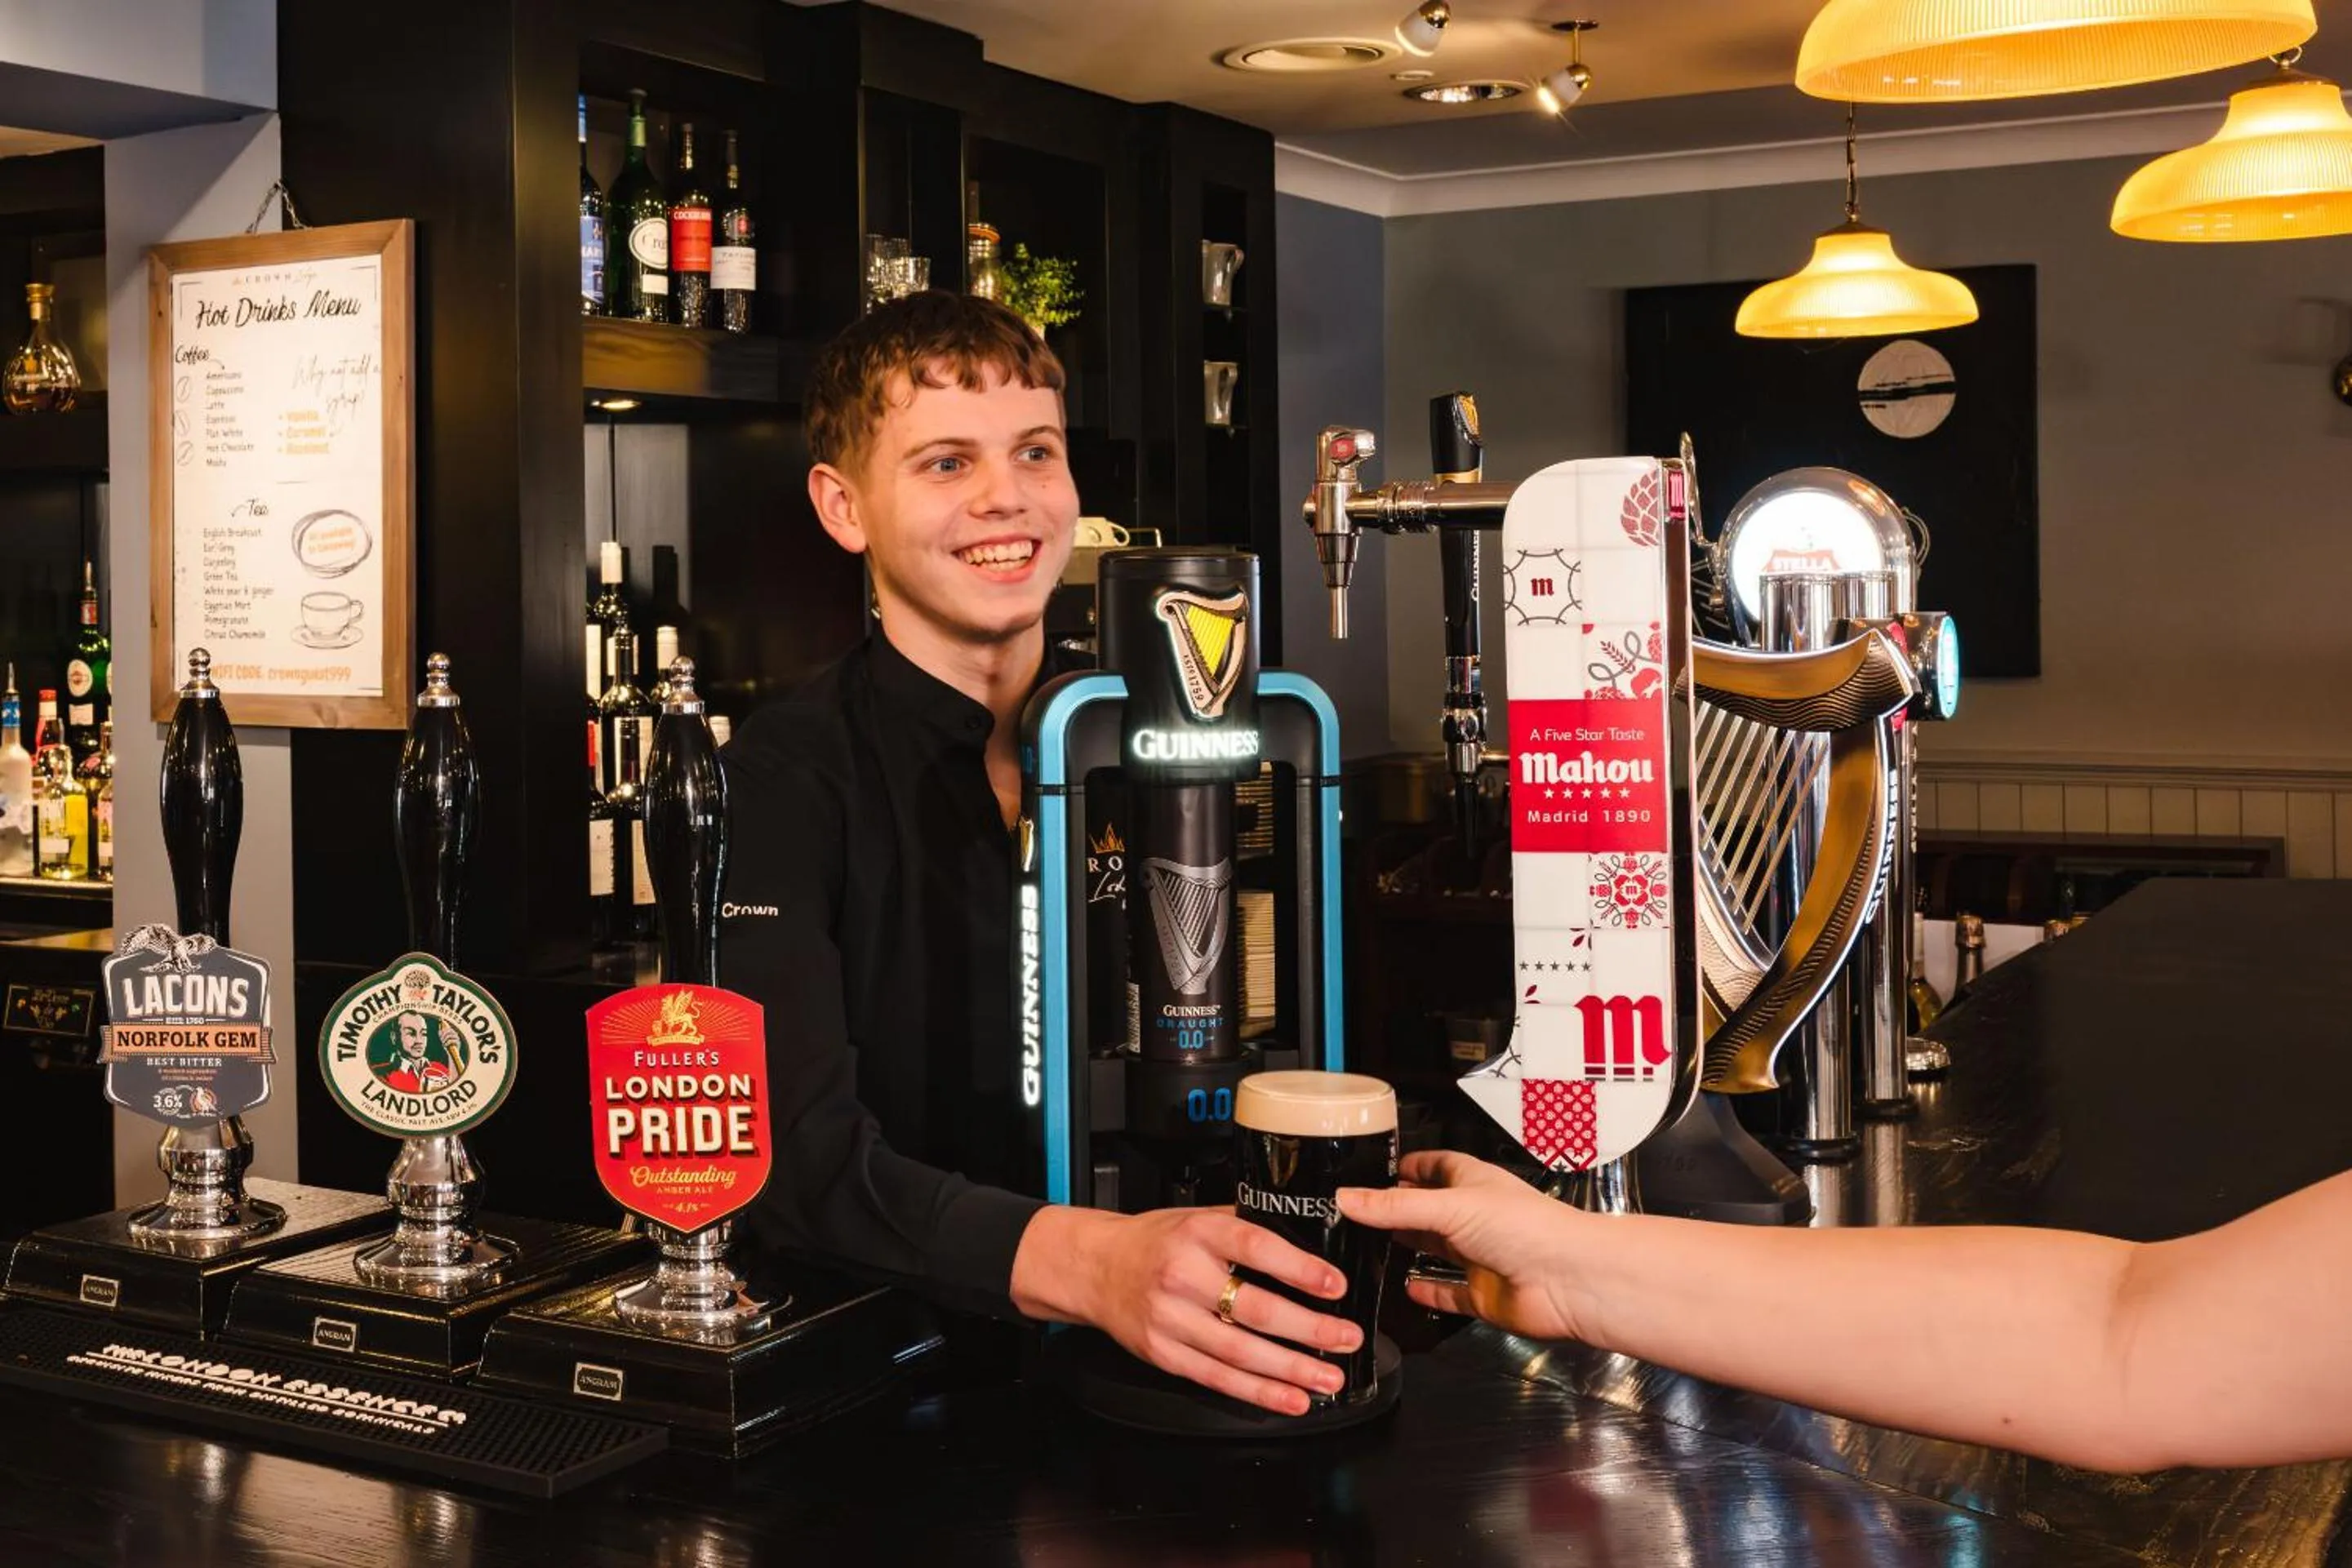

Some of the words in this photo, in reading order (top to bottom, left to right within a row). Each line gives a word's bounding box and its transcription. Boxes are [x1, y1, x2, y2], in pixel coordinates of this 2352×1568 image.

[196, 300, 229, 329] Hot
[235, 295, 296, 328] Drinks
[303, 290, 362, 318] Menu
[175, 345, 210, 365] Coffee
[247, 498, 269, 517] Tea
[1530, 729, 1541, 741] A
[1545, 728, 1572, 742] Five
[1576, 728, 1605, 742] Star
[1607, 727, 1645, 741] Taste
[1133, 729, 1259, 761] GUINNESS
[1527, 809, 1589, 824] Madrid
[1602, 809, 1652, 824] 1890
[722, 902, 779, 918] Crown
[123, 975, 250, 1019] LACONS
[1020, 884, 1041, 1106] GUINNESS
[1163, 1004, 1217, 1017] GUINNESS
[337, 984, 402, 1063] TIMOTHY
[432, 984, 501, 1065] TAYLOR'S
[1156, 1018, 1223, 1028] DRAUGHT
[117, 1030, 210, 1049] NORFOLK
[214, 1030, 257, 1049] GEM
[1179, 1030, 1204, 1050] 0.0
[147, 1058, 174, 1067] BEST
[180, 1058, 222, 1067] BITTER
[634, 1048, 720, 1068] FULLER'S
[606, 1073, 751, 1099] LONDON
[153, 1095, 183, 1108] 3.6%
[360, 1079, 478, 1117] LANDLORD
[1187, 1088, 1232, 1122] 0.0
[607, 1105, 755, 1154] PRIDE
[629, 1164, 737, 1189] Outstanding
[656, 1186, 691, 1194] AMBER
[694, 1186, 714, 1194] ALE
[1238, 1182, 1341, 1218] GUINNESS
[318, 1329, 351, 1342] ANGRAM
[283, 1379, 438, 1418] ESSENCE
